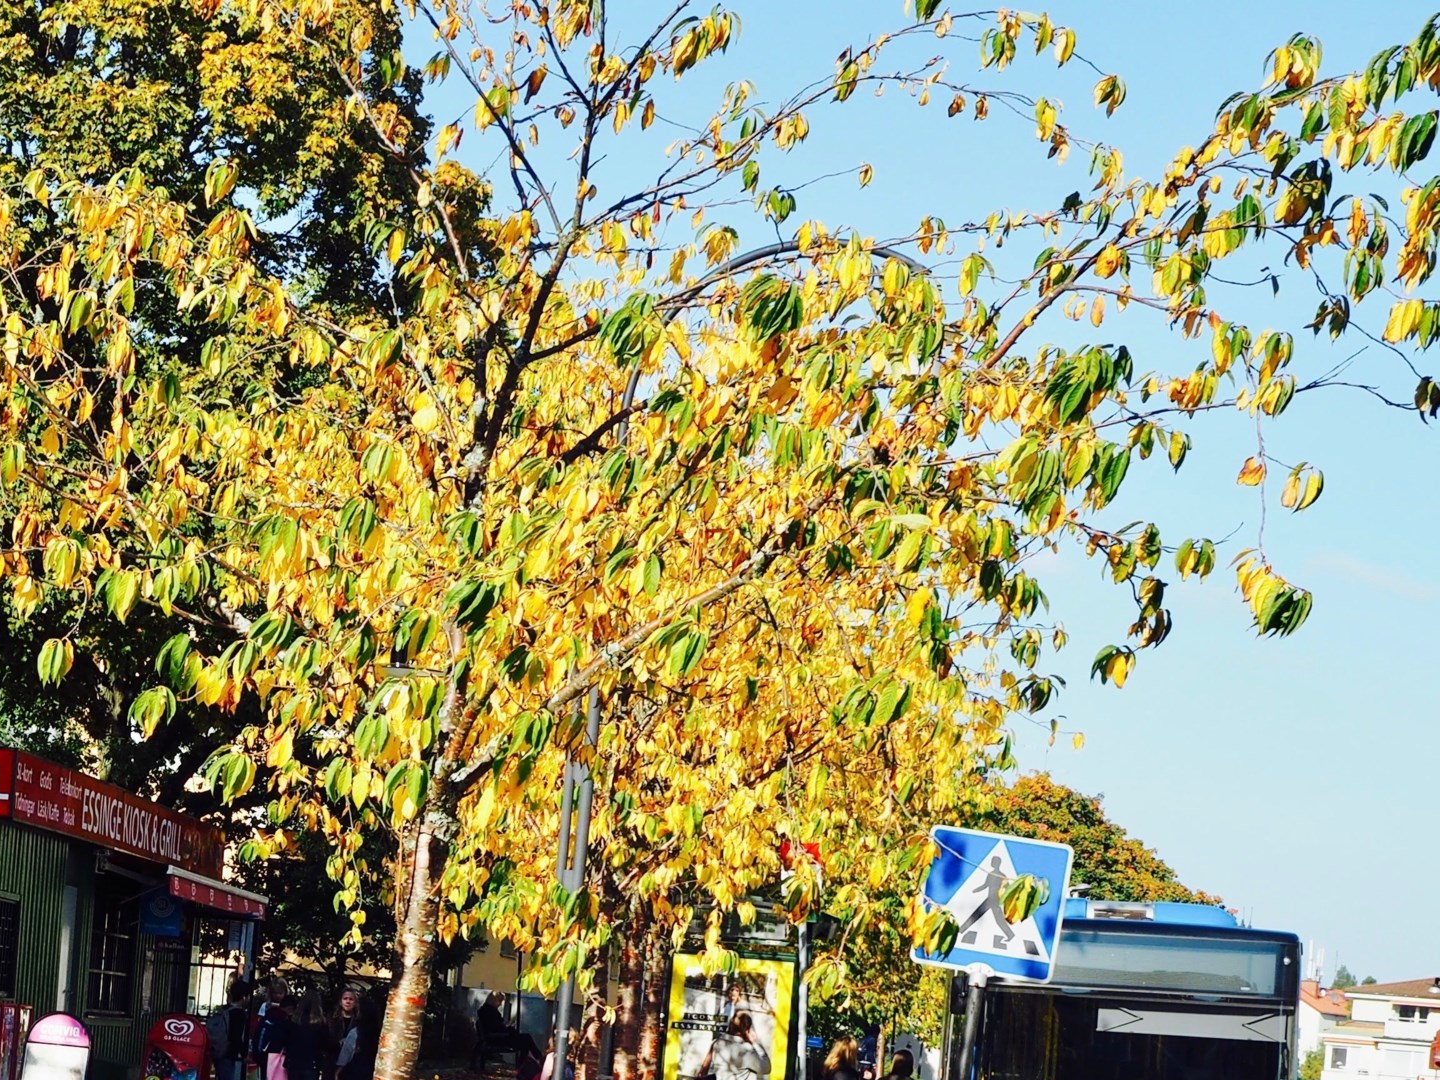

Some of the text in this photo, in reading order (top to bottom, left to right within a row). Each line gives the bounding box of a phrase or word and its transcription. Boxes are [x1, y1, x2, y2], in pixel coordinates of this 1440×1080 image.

[40, 771, 53, 790] Godis
[15, 792, 35, 817] Tidningar
[81, 788, 182, 861] ESSINGE KIOSK & GRILL
